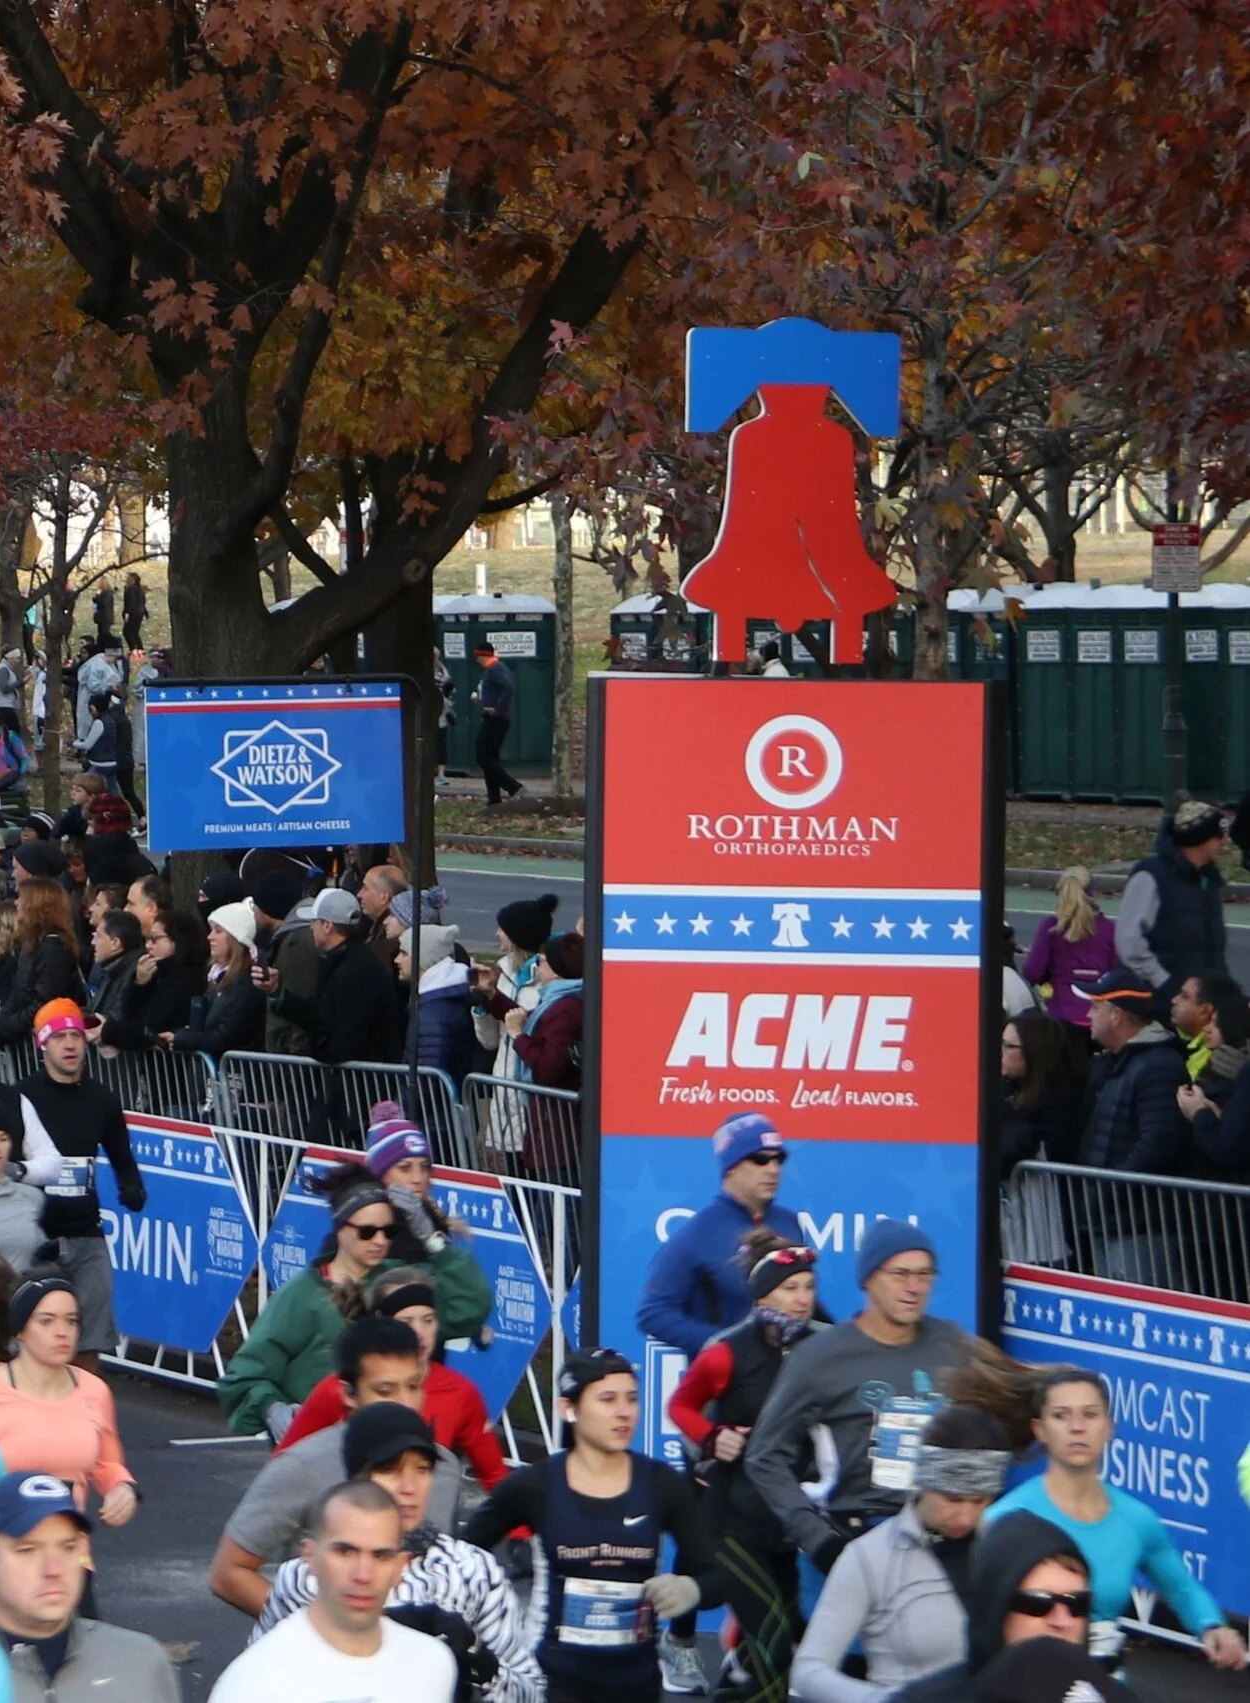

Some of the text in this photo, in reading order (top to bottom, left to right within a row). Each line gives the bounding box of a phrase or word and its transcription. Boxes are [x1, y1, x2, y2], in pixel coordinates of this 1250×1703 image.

[248, 744, 312, 765] DIETZ &
[777, 745, 815, 777] R
[236, 764, 313, 786] WATSON
[204, 819, 351, 834] PREMIUM MEATS ARTISAN CHEESES
[686, 813, 899, 842] ROTHMAN
[713, 841, 872, 857] ORTHOPAEDICS
[664, 991, 913, 1072] ACME
[658, 1076, 919, 1110] Fresh FOODS. Local FLAVORS.
